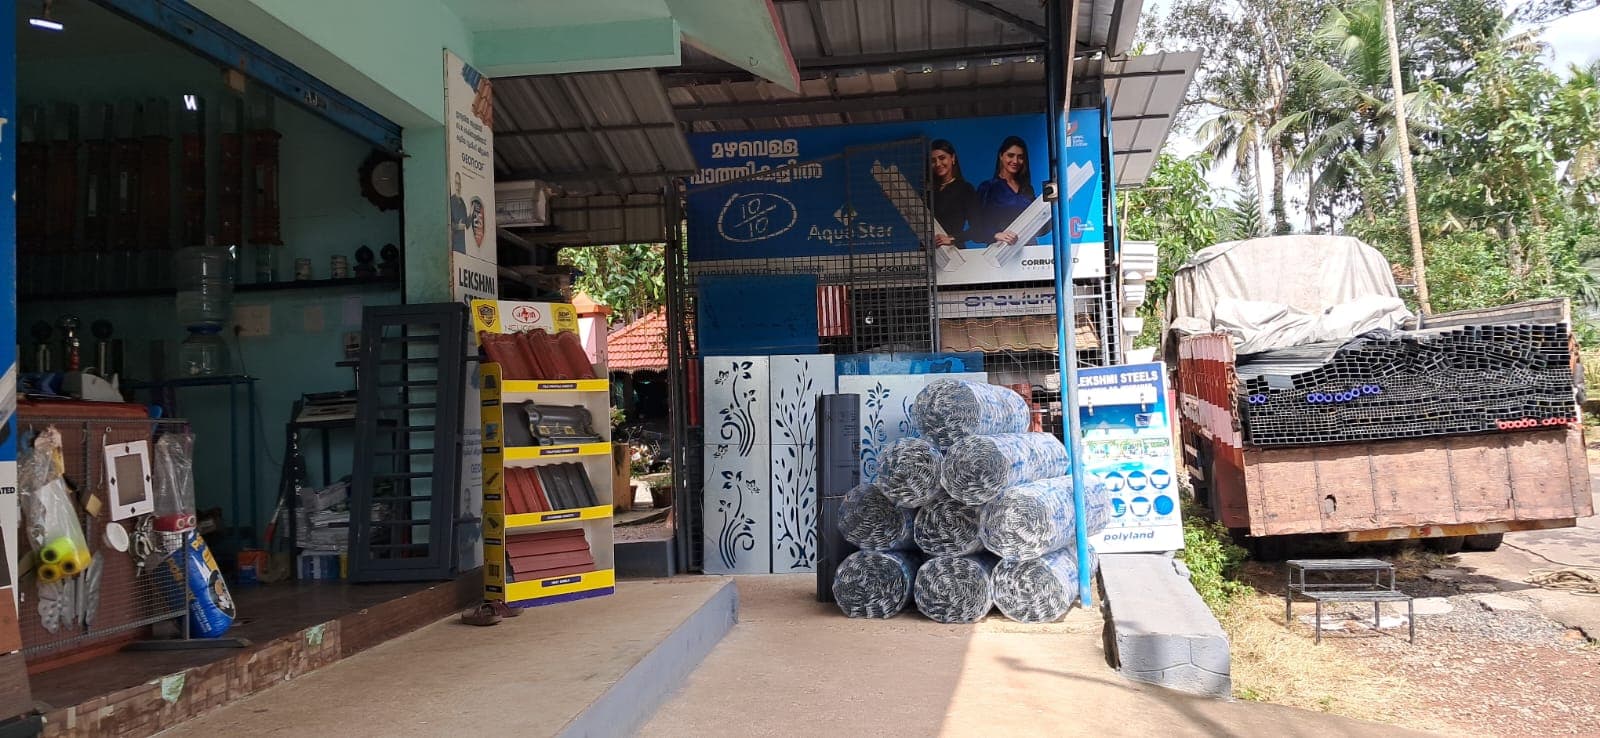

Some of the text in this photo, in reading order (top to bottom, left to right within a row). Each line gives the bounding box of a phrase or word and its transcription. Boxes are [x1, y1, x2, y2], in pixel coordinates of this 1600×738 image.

[807, 222, 894, 244] Aqua Star
[459, 268, 495, 296] LEKSHMI
[1120, 370, 1159, 384] STEELS
[1103, 530, 1155, 542] polyland
